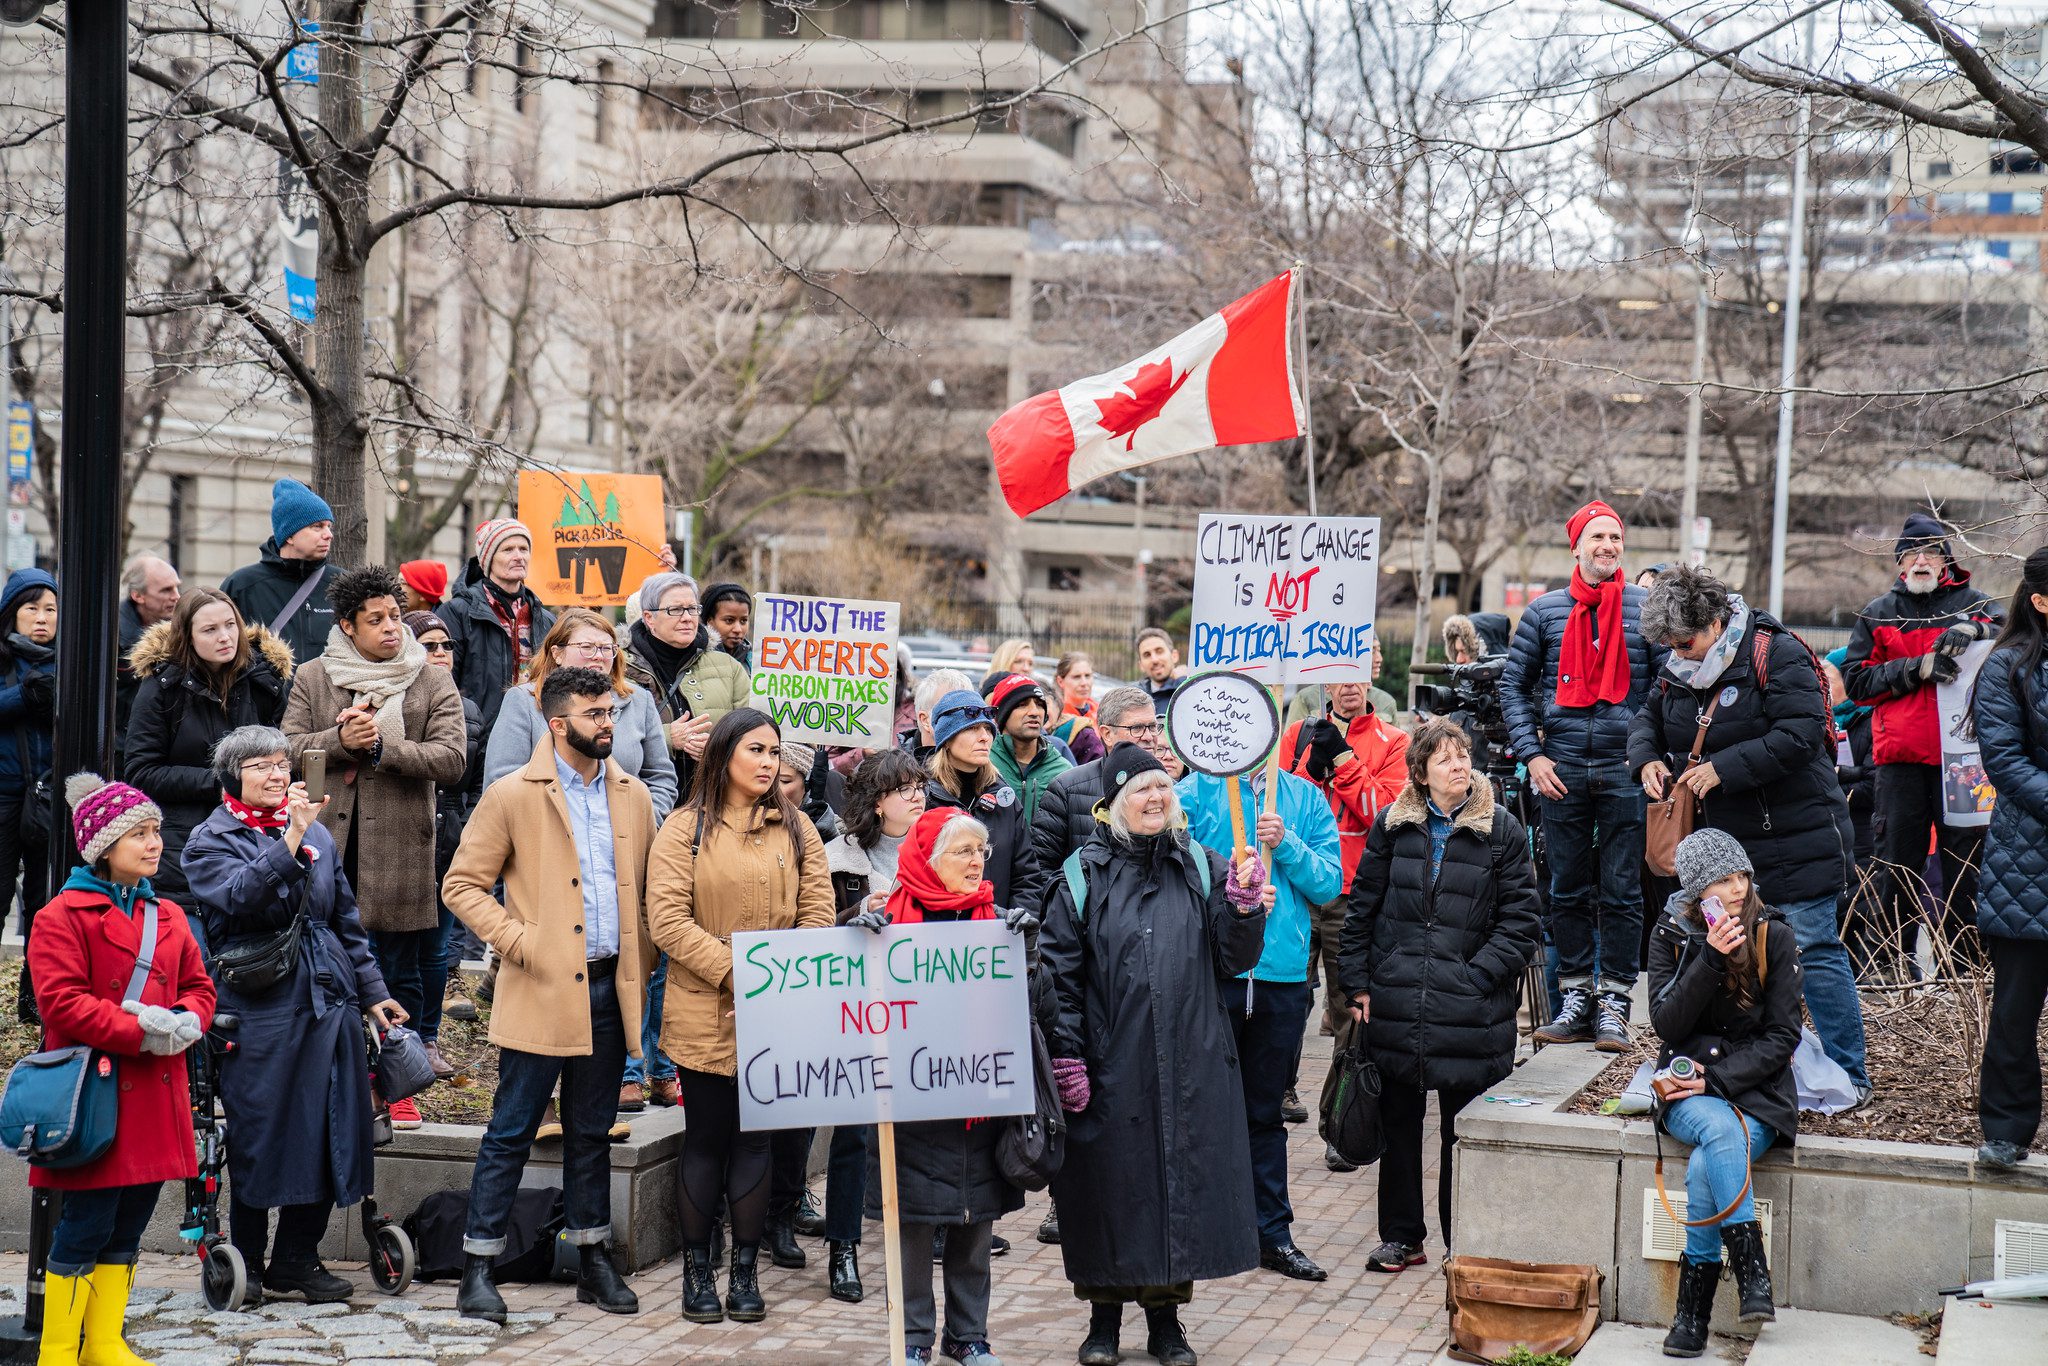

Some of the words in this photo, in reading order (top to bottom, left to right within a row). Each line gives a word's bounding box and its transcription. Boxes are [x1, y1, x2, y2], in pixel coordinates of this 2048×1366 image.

[1200, 520, 1292, 567] CLIMATE
[1301, 522, 1374, 562] CHANGE
[1234, 573, 1254, 607] is
[1264, 566, 1320, 612] NOT
[1332, 582, 1344, 605] a
[766, 598, 845, 634] TRUST
[849, 609, 886, 631] THE
[1195, 622, 1298, 667] POLITICAL
[1302, 620, 1372, 660] ISSUE
[752, 672, 830, 701] CARBON
[831, 678, 889, 705] TAXES
[768, 697, 871, 736] WORK
[1193, 699, 1215, 715] in
[1219, 703, 1254, 725] love
[1197, 718, 1237, 733] with
[1192, 745, 1239, 768] Earth
[745, 942, 865, 999] SYSTEM
[888, 938, 1014, 983] CHANGE
[841, 1000, 918, 1034] NOT
[745, 1048, 893, 1104] CLIMATE
[910, 1046, 1015, 1091] CHANGE
